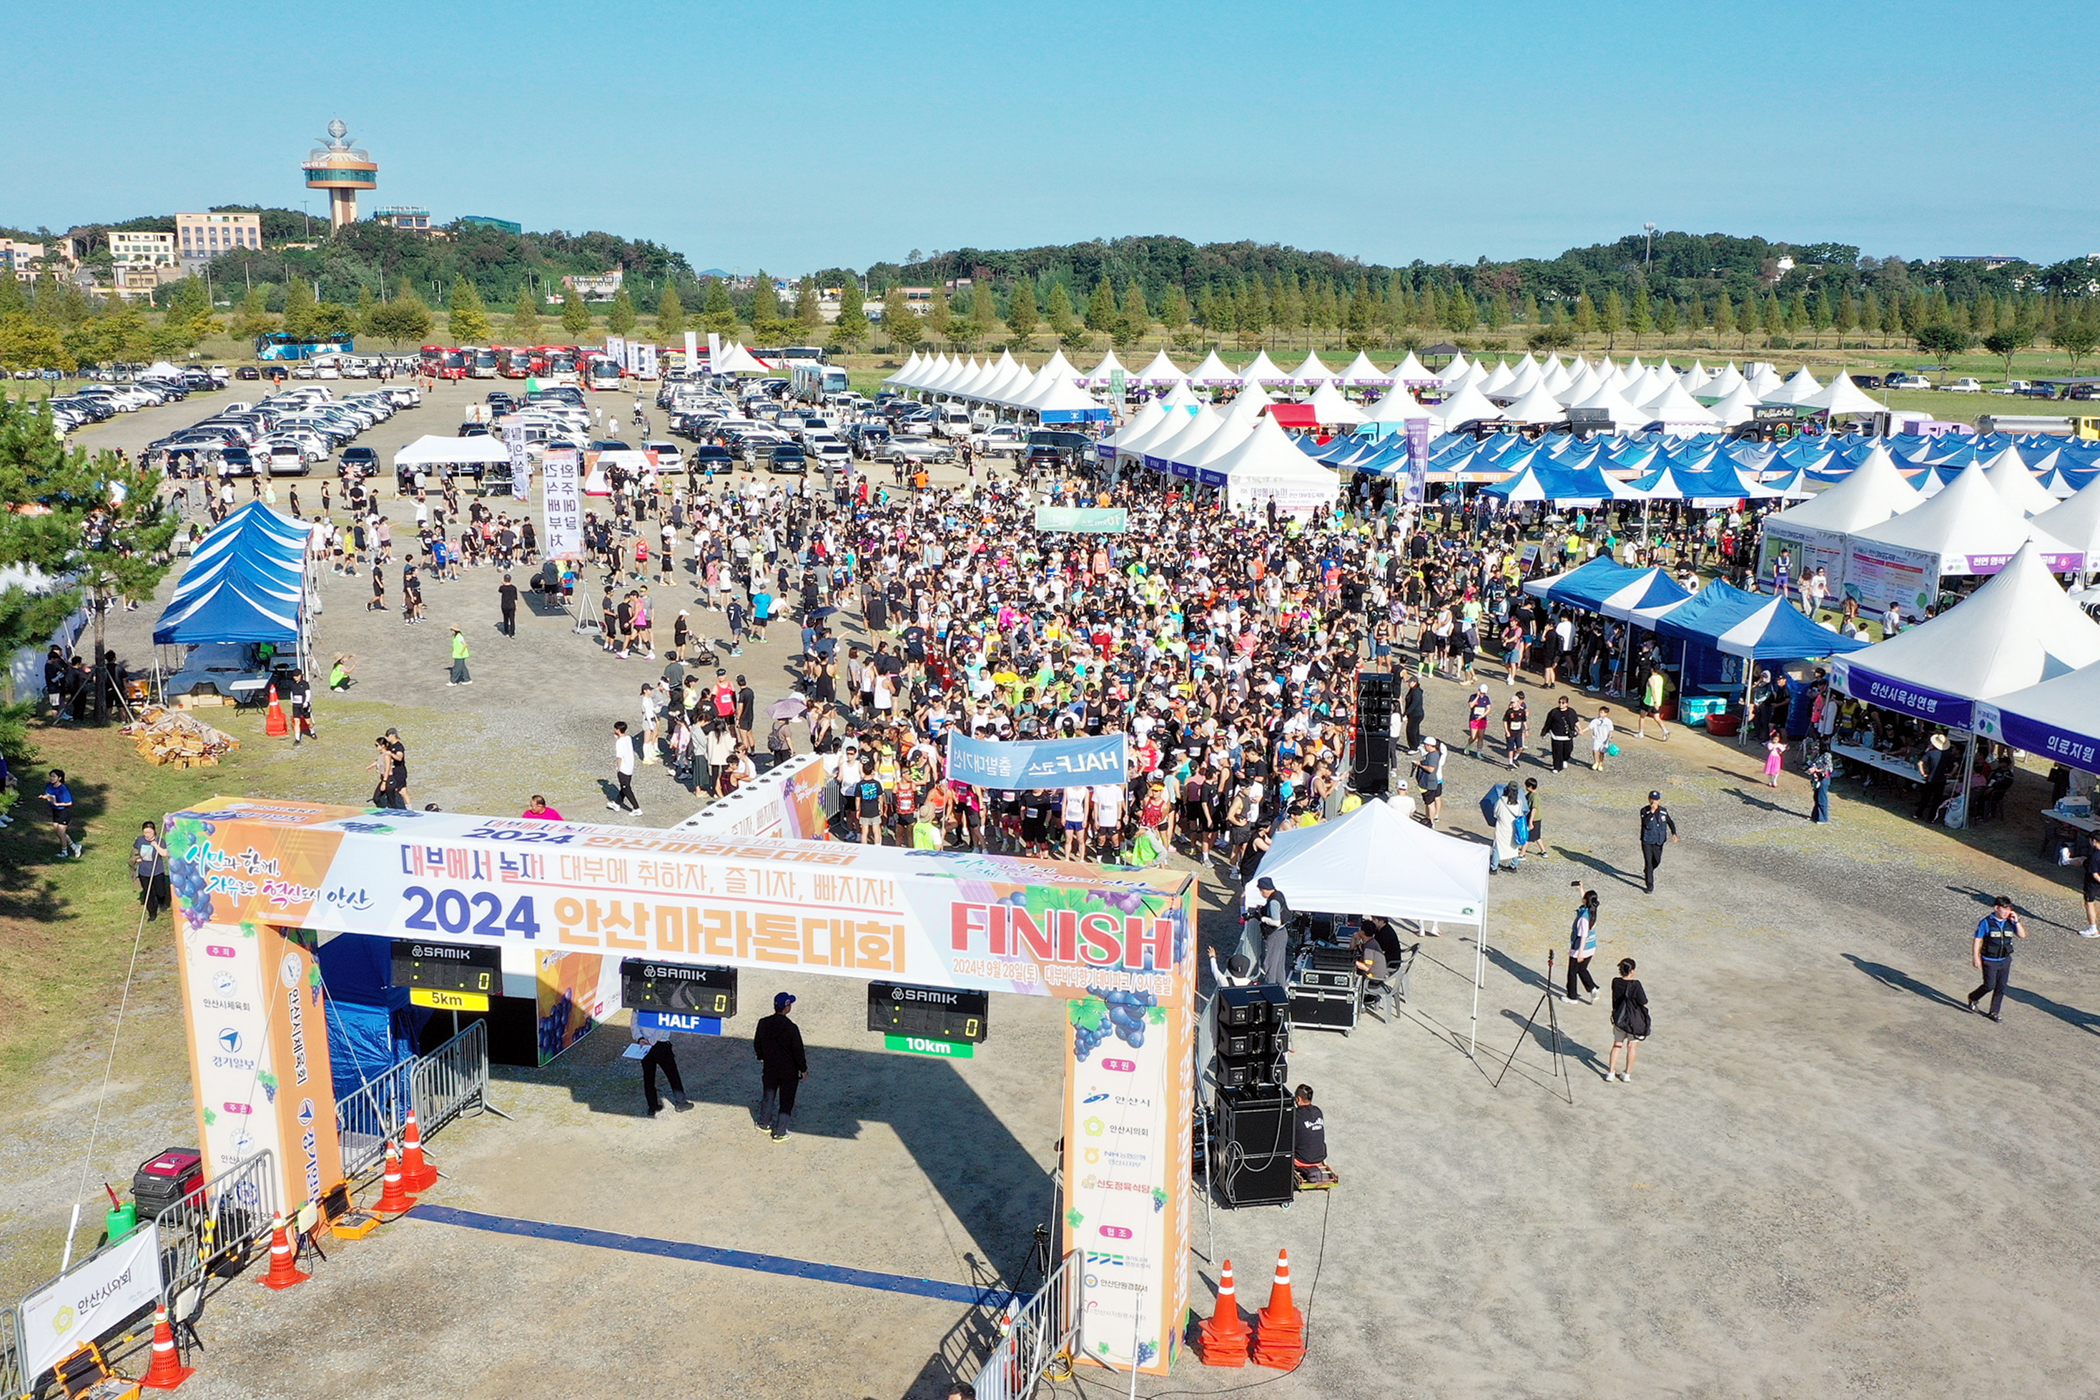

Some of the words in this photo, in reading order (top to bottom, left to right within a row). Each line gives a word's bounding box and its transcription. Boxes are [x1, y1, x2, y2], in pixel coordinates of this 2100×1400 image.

[1870, 681, 1939, 714] 안산시육상연맹
[2046, 735, 2096, 764] 의료지원
[462, 828, 576, 845] 2024
[401, 844, 492, 882] 대부에서
[500, 852, 545, 880] 놀자!
[560, 854, 628, 885] 대부에
[638, 860, 715, 894] 취하자,
[724, 866, 804, 902] 즐기자,
[814, 874, 894, 906] 빠지자!
[327, 887, 376, 910] 안산
[402, 886, 541, 940] 2024
[554, 896, 906, 974] 안산마라톤대회
[951, 901, 1174, 970] FINISH
[424, 947, 470, 960] SAMIK
[657, 968, 707, 981] SAMIK
[952, 958, 986, 977] 2024년
[986, 961, 1002, 978] 9월
[1002, 963, 1040, 984] 28일(토)
[1153, 976, 1174, 996] 출발
[203, 998, 251, 1012] 안산시체육회
[431, 992, 463, 1006] 5km
[905, 990, 958, 1004] SAMIK
[658, 1012, 700, 1030] HALF
[288, 988, 308, 1085] 안산시체육회
[906, 1037, 952, 1054] 10km
[212, 1056, 255, 1070] 경기일보
[1114, 1096, 1150, 1108] 안산시
[1110, 1124, 1149, 1137] 안산시의회
[78, 1267, 132, 1316] 안산시의회
[1100, 1278, 1148, 1293] 안산단원경찰서
